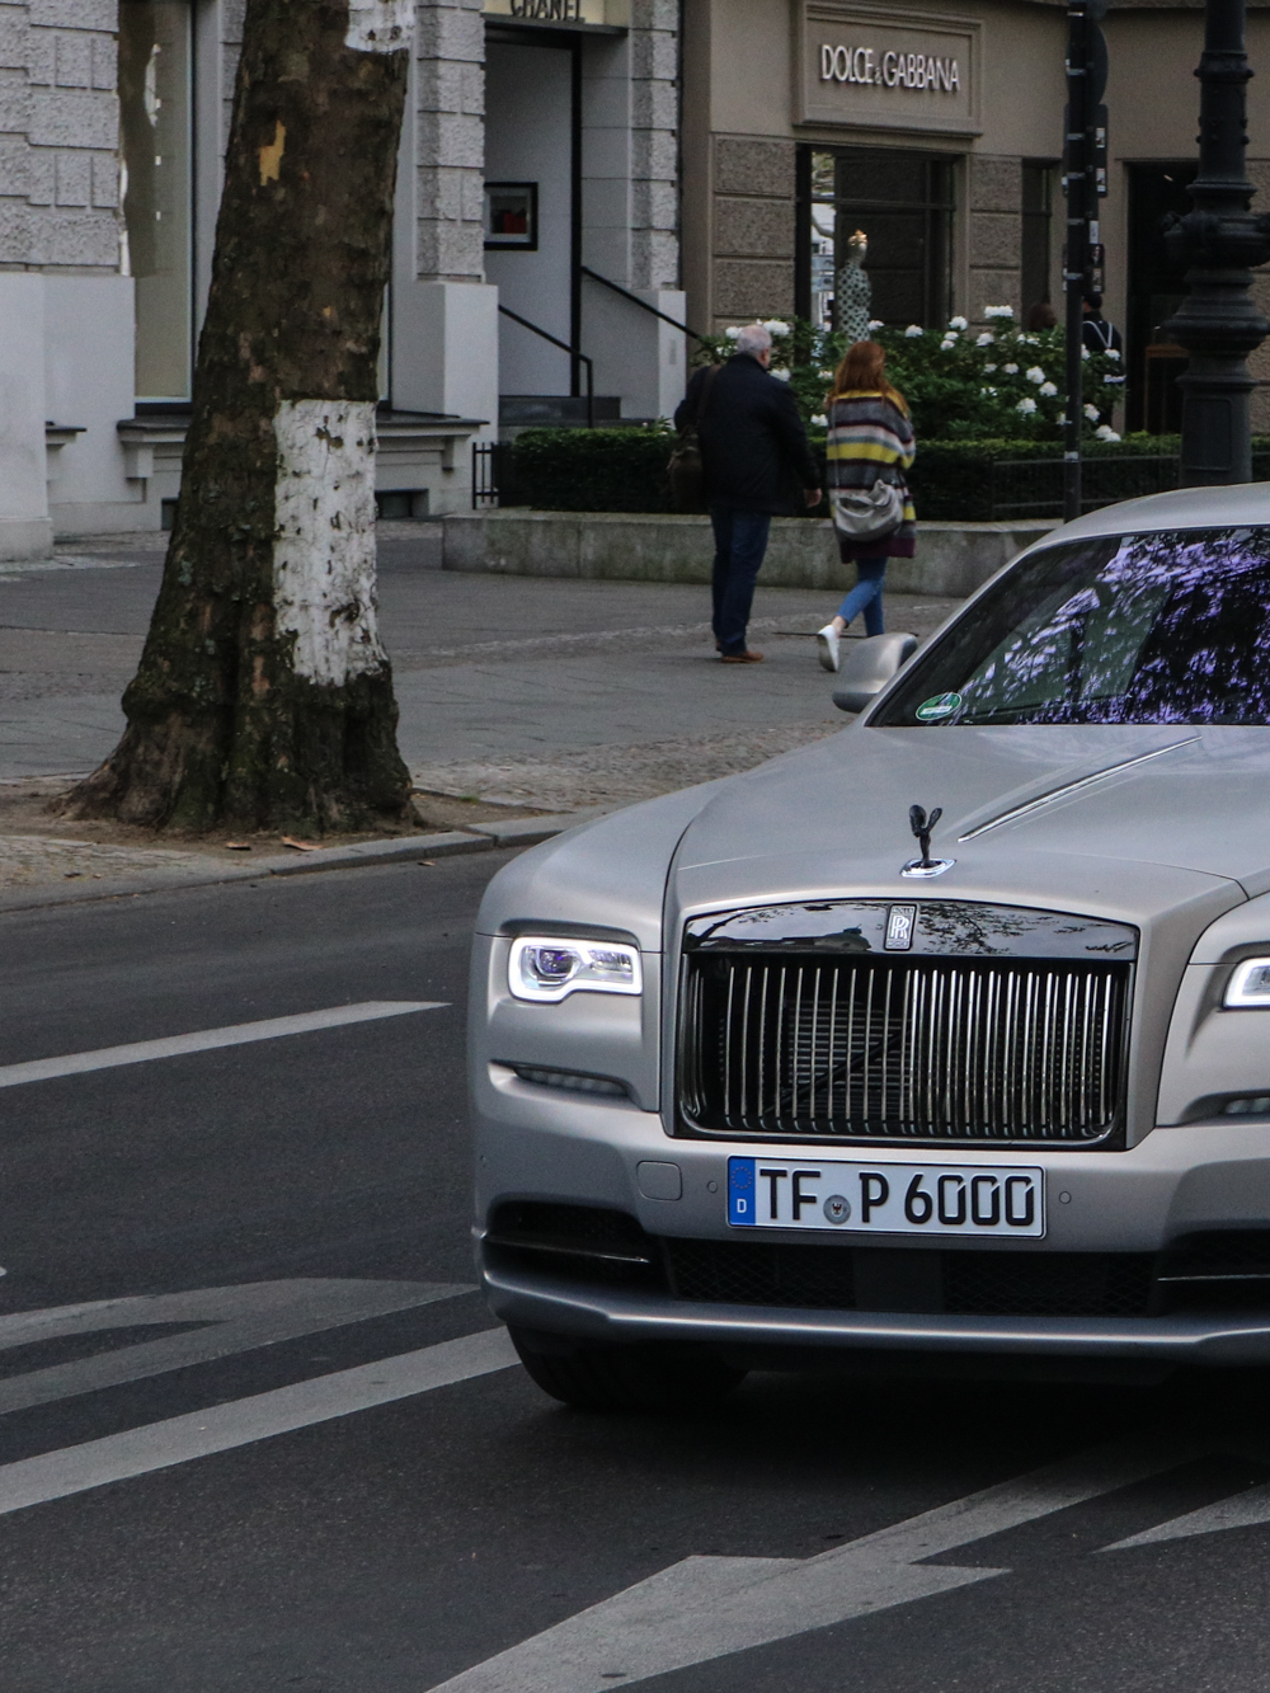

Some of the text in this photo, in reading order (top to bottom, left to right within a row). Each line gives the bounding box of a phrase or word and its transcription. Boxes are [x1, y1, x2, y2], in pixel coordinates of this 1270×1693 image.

[822, 45, 874, 84] DOLCE
[883, 51, 960, 91] GABBANA
[736, 1198, 748, 1213] D
[759, 1167, 1035, 1226] TF P 6000
